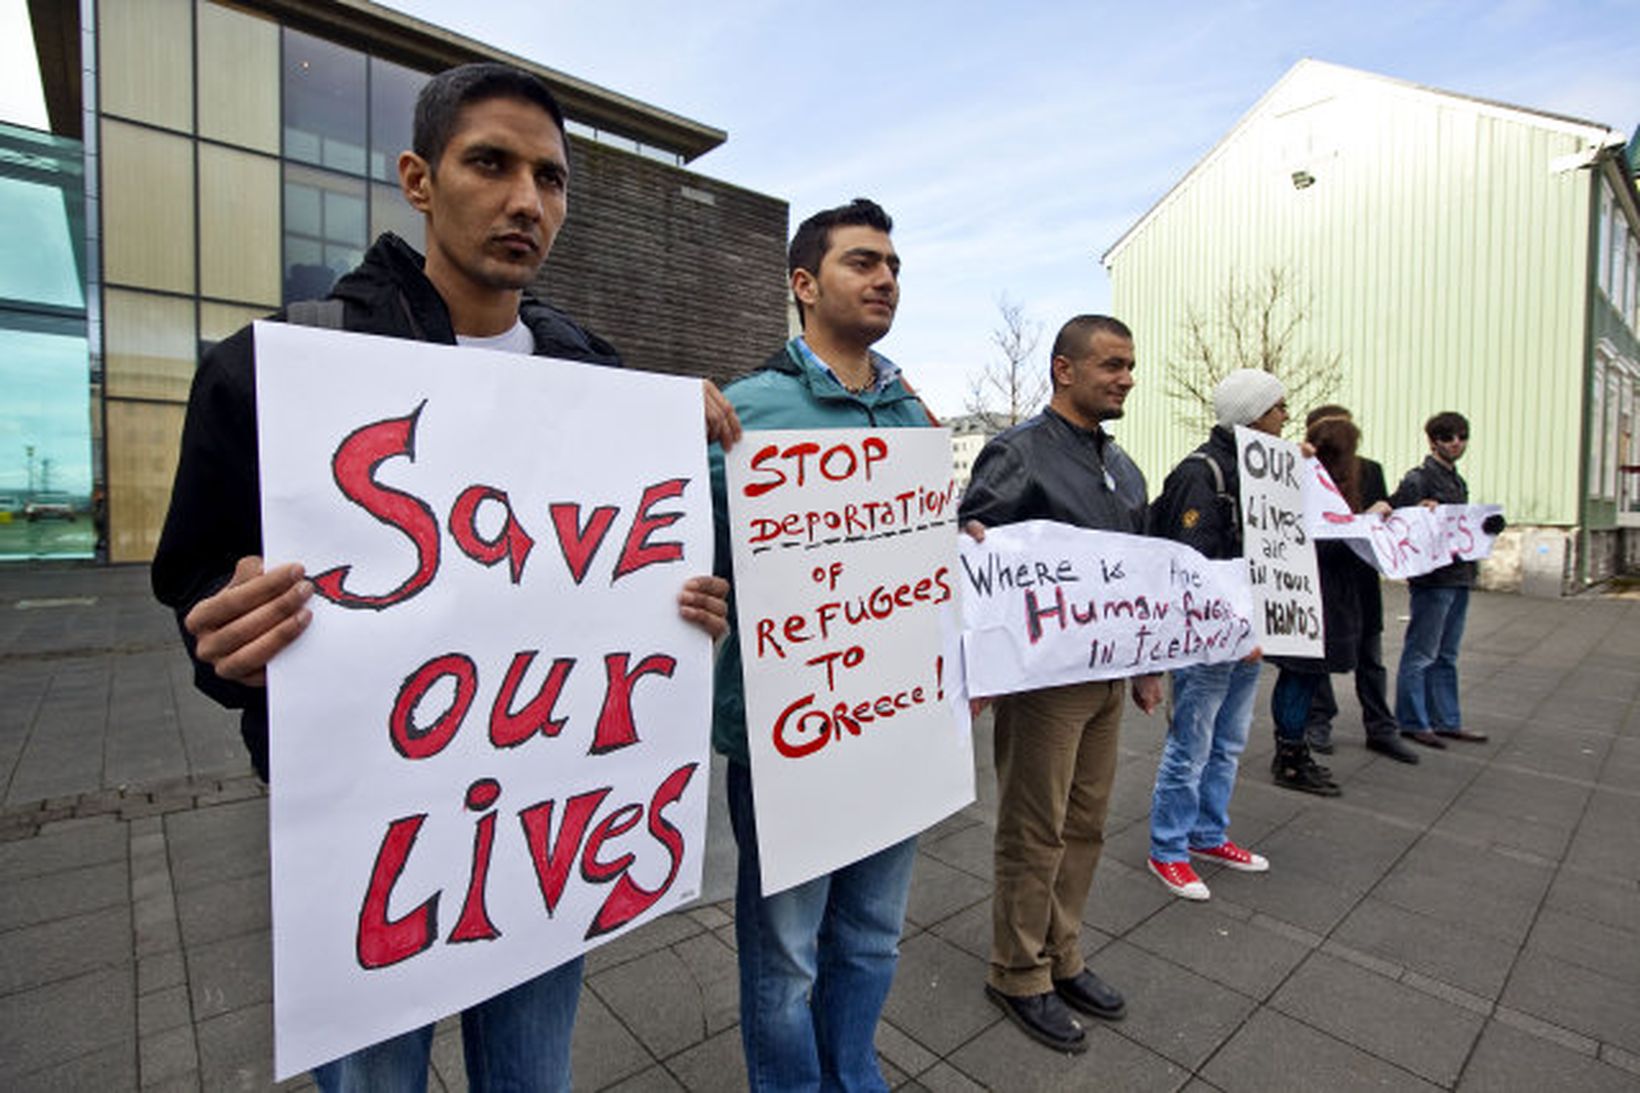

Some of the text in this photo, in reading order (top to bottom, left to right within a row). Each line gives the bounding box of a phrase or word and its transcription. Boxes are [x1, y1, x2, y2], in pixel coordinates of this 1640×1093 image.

[743, 436, 888, 497] STOP
[1244, 439, 1300, 490] OUR
[1273, 567, 1313, 596] YOUR
[388, 650, 676, 760] our
